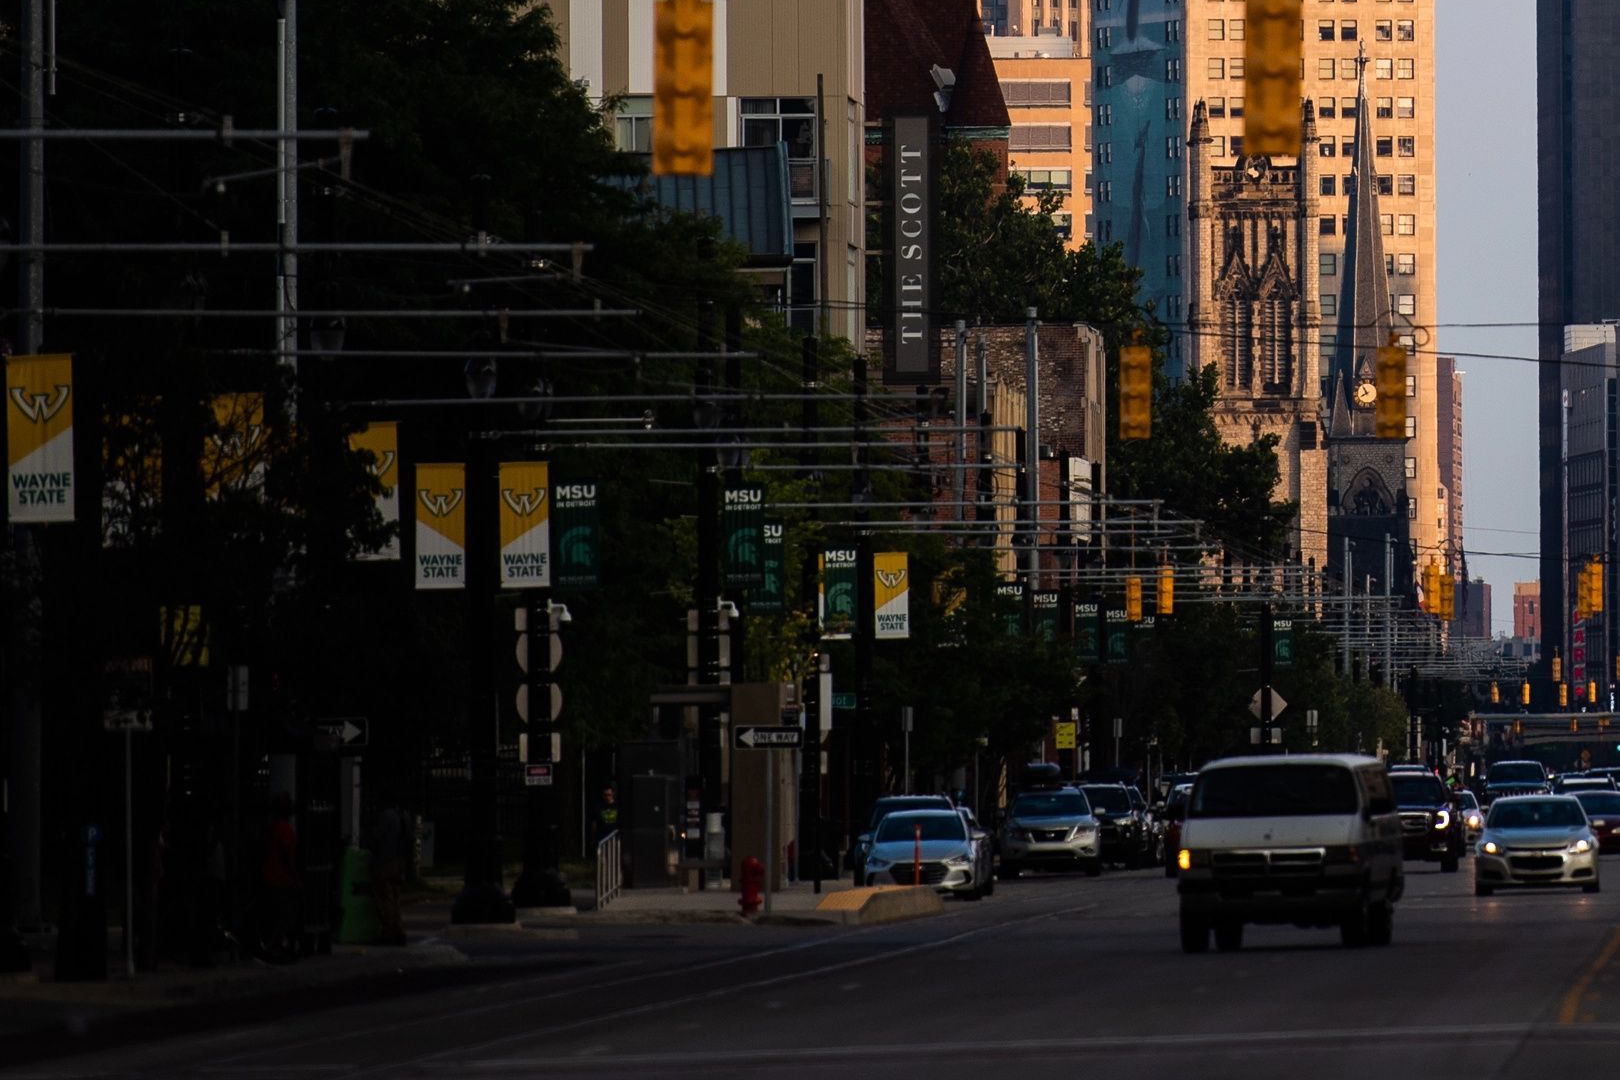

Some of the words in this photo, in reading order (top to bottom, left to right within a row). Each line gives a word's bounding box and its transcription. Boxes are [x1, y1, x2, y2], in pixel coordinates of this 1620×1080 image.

[901, 144, 923, 260] SCOTT
[901, 273, 923, 345] THE
[13, 471, 71, 488] WAYNE
[19, 489, 66, 505] STATE
[555, 485, 596, 500] MSU
[725, 488, 762, 503] MSU
[763, 524, 783, 537] SU
[419, 554, 463, 566] WAYNE
[503, 553, 547, 565] WAYNE
[825, 549, 856, 562] MSU
[423, 566, 458, 578] STATE
[508, 566, 543, 577] STATE
[997, 586, 1023, 596] MSU
[1033, 593, 1058, 603] MSU
[1075, 603, 1098, 613] MSU
[876, 613, 906, 622] WAYNE
[1106, 610, 1128, 619] MSU
[880, 622, 904, 630] STATE
[1273, 620, 1292, 628] MSU
[753, 732, 773, 743] ONE
[776, 732, 795, 743] WAY
